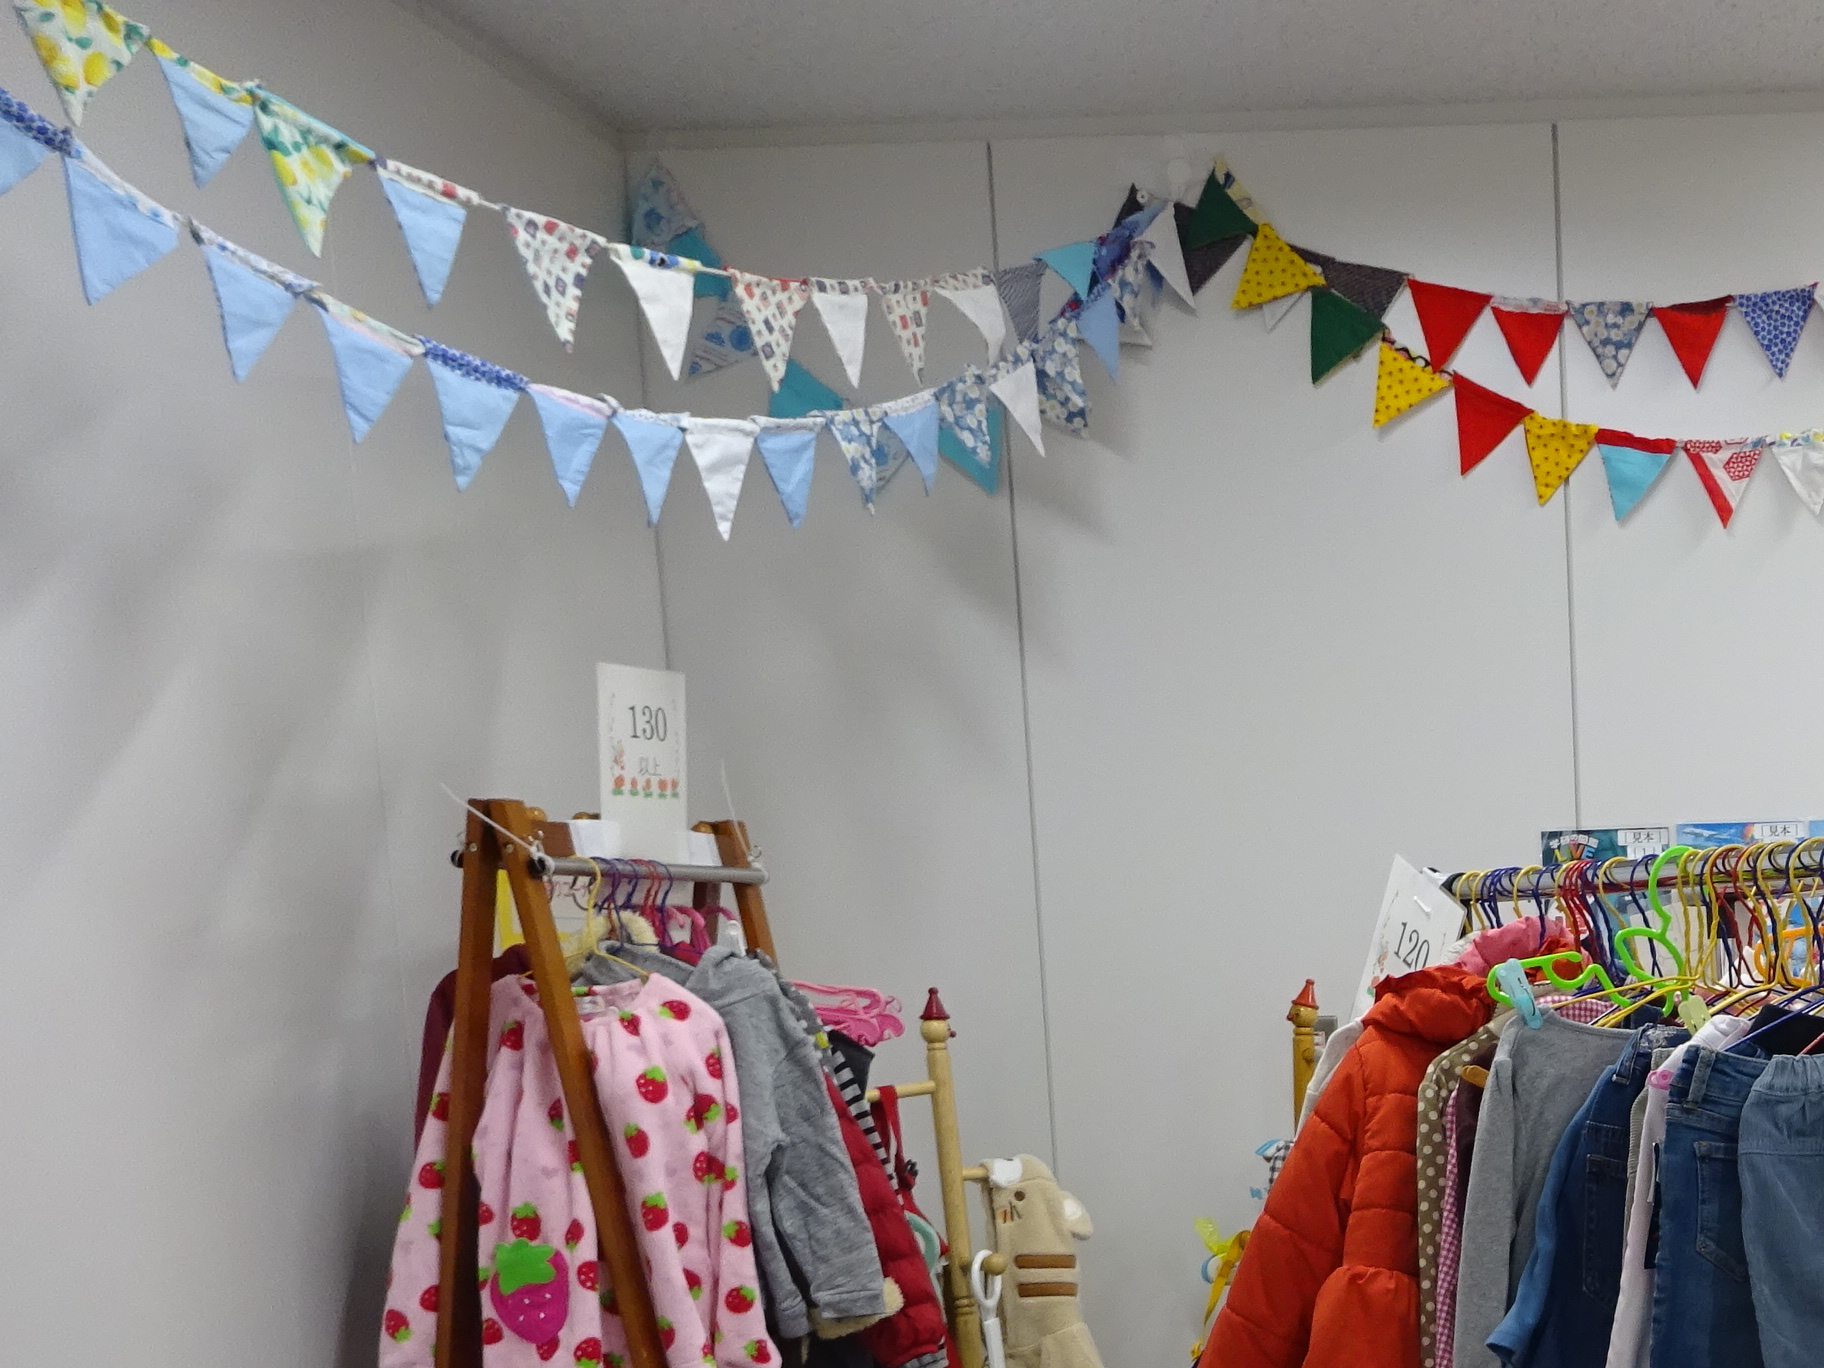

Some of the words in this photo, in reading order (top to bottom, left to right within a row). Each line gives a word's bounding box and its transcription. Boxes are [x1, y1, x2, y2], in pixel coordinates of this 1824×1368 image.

[628, 704, 667, 742] 130
[638, 756, 661, 777] 以上
[1633, 831, 1654, 843] 見本
[1769, 824, 1791, 837] 見本
[1554, 844, 1596, 863] LIVE
[1394, 921, 1430, 971] 120
